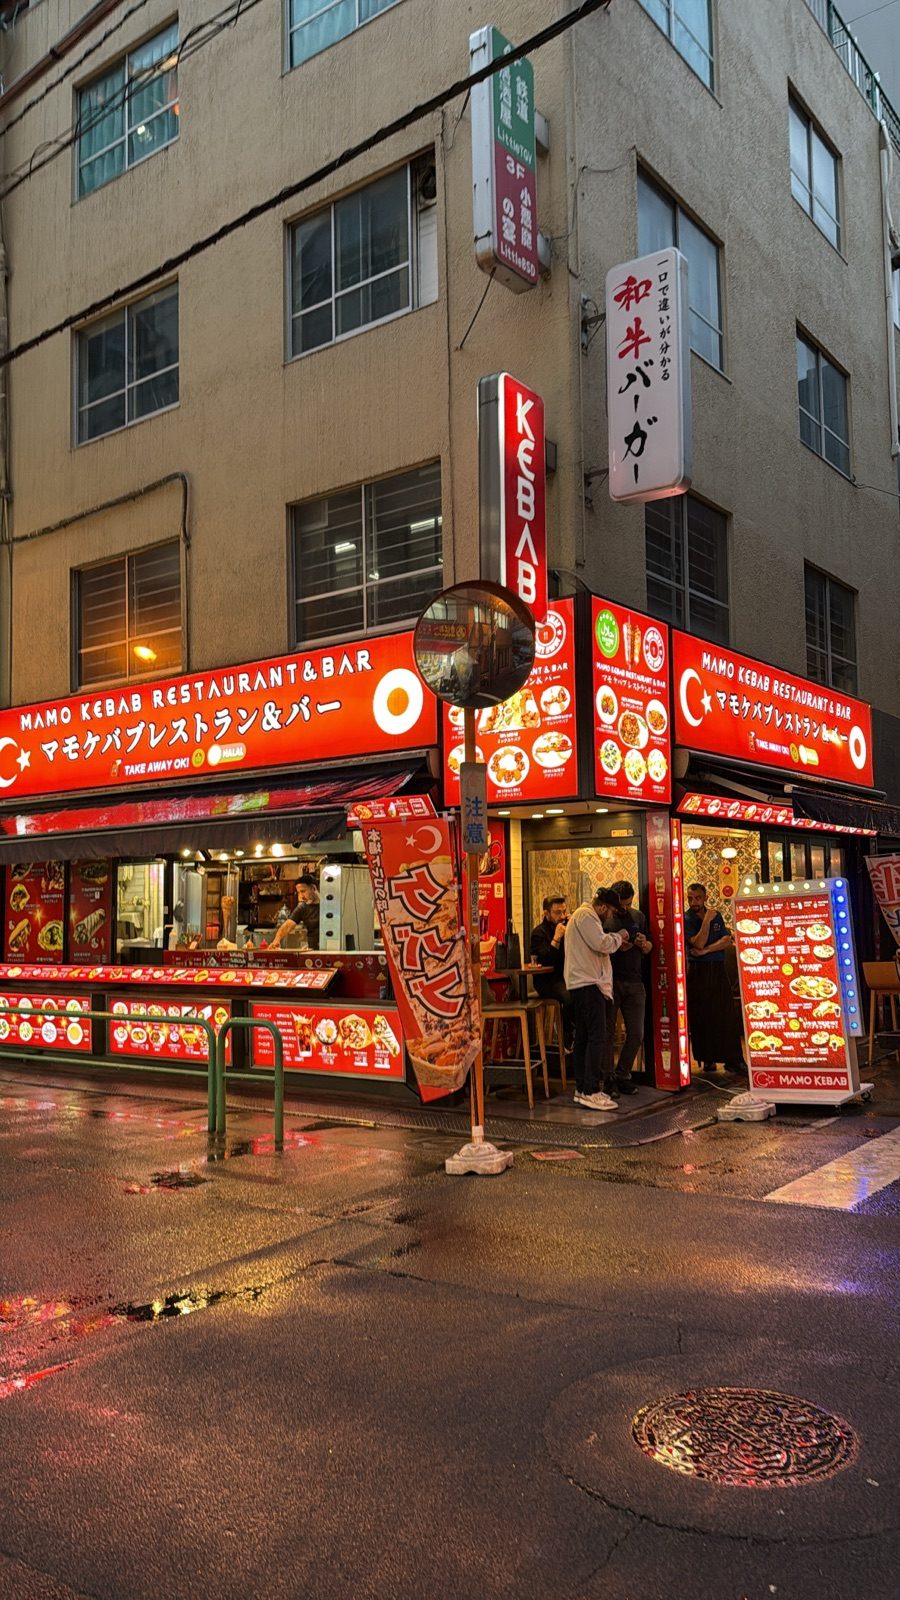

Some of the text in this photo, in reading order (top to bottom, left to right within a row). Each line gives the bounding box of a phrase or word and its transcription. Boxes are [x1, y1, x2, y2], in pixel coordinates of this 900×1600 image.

[506, 154, 525, 180] 3F
[656, 258, 671, 382] 一口で違いが分かる
[611, 274, 659, 485] 和牛バーガー
[514, 391, 539, 605] KEBAB
[551, 662, 569, 673] BAR
[702, 651, 735, 678] MAMO
[738, 666, 770, 692] KEBAB
[20, 706, 72, 732] MAMO
[80, 693, 143, 721] KEBAB
[124, 763, 146, 776] TAKE
[147, 759, 173, 774] AWAY
[464, 795, 485, 844] 注意
[779, 1074, 848, 1086] MAMO KEBAB
